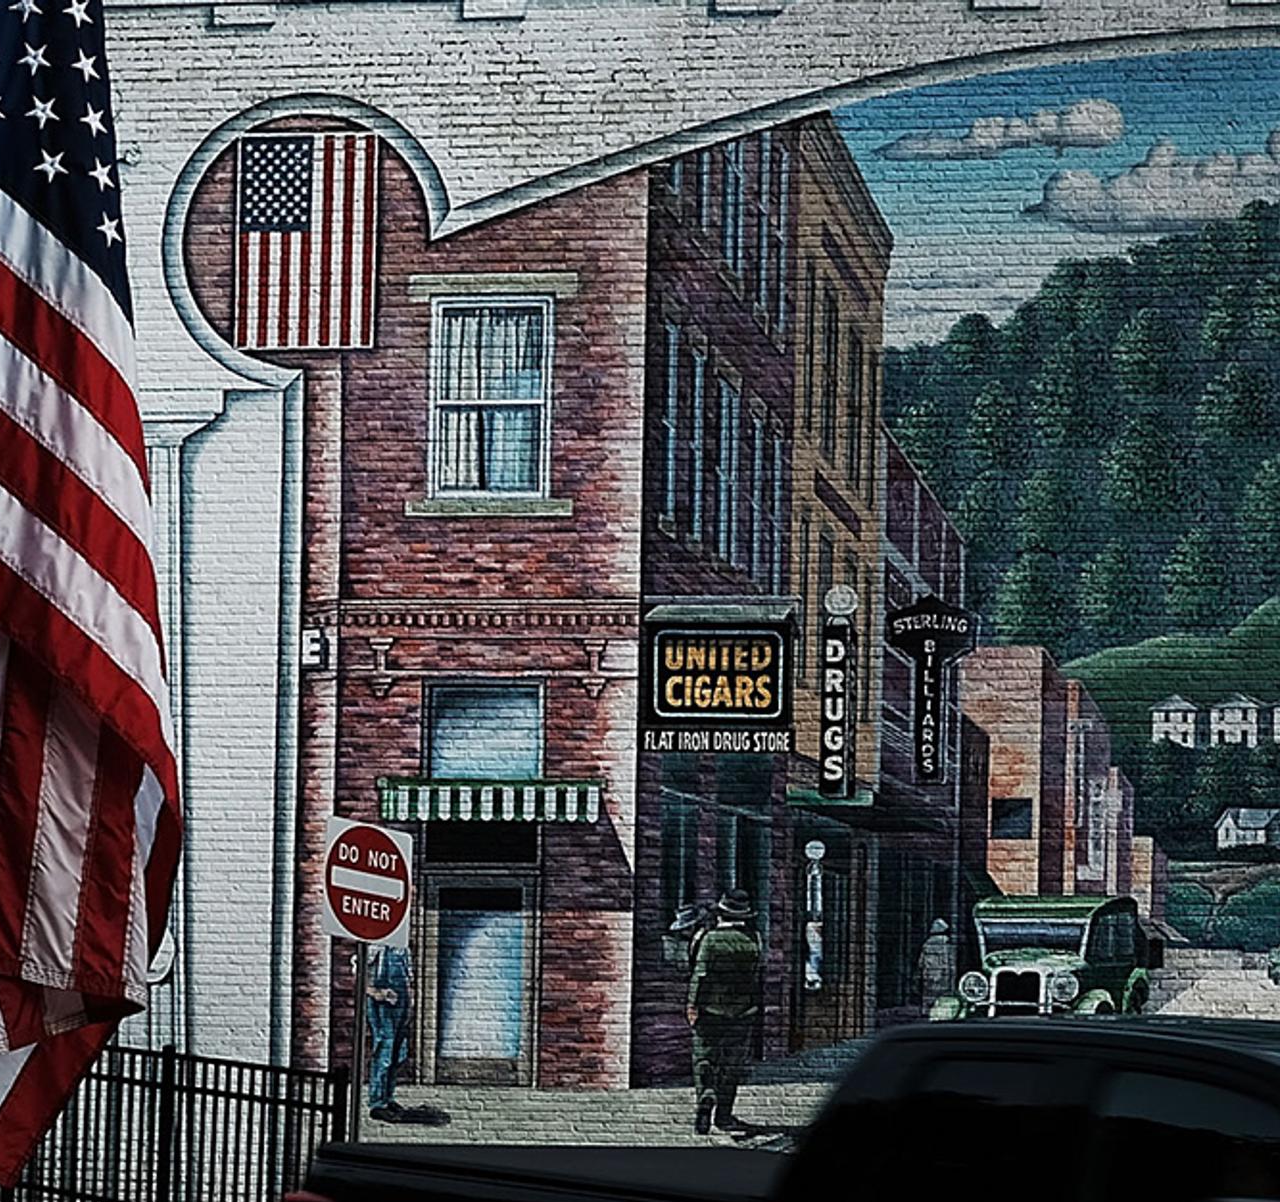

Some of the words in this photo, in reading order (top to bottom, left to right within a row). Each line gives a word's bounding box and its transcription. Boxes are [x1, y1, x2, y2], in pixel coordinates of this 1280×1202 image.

[892, 612, 968, 634] STERLING
[664, 640, 773, 671] UNITED
[664, 674, 773, 710] CIGARS
[921, 639, 937, 774] BILLIARDS
[822, 638, 845, 781] DRUGS
[643, 730, 675, 751] FLAT
[677, 731, 709, 751] IRON
[713, 730, 751, 751] DRUG
[753, 731, 791, 752] STORE
[338, 842, 359, 864] DO
[367, 850, 399, 872] NOT
[342, 895, 391, 922] ENTER
